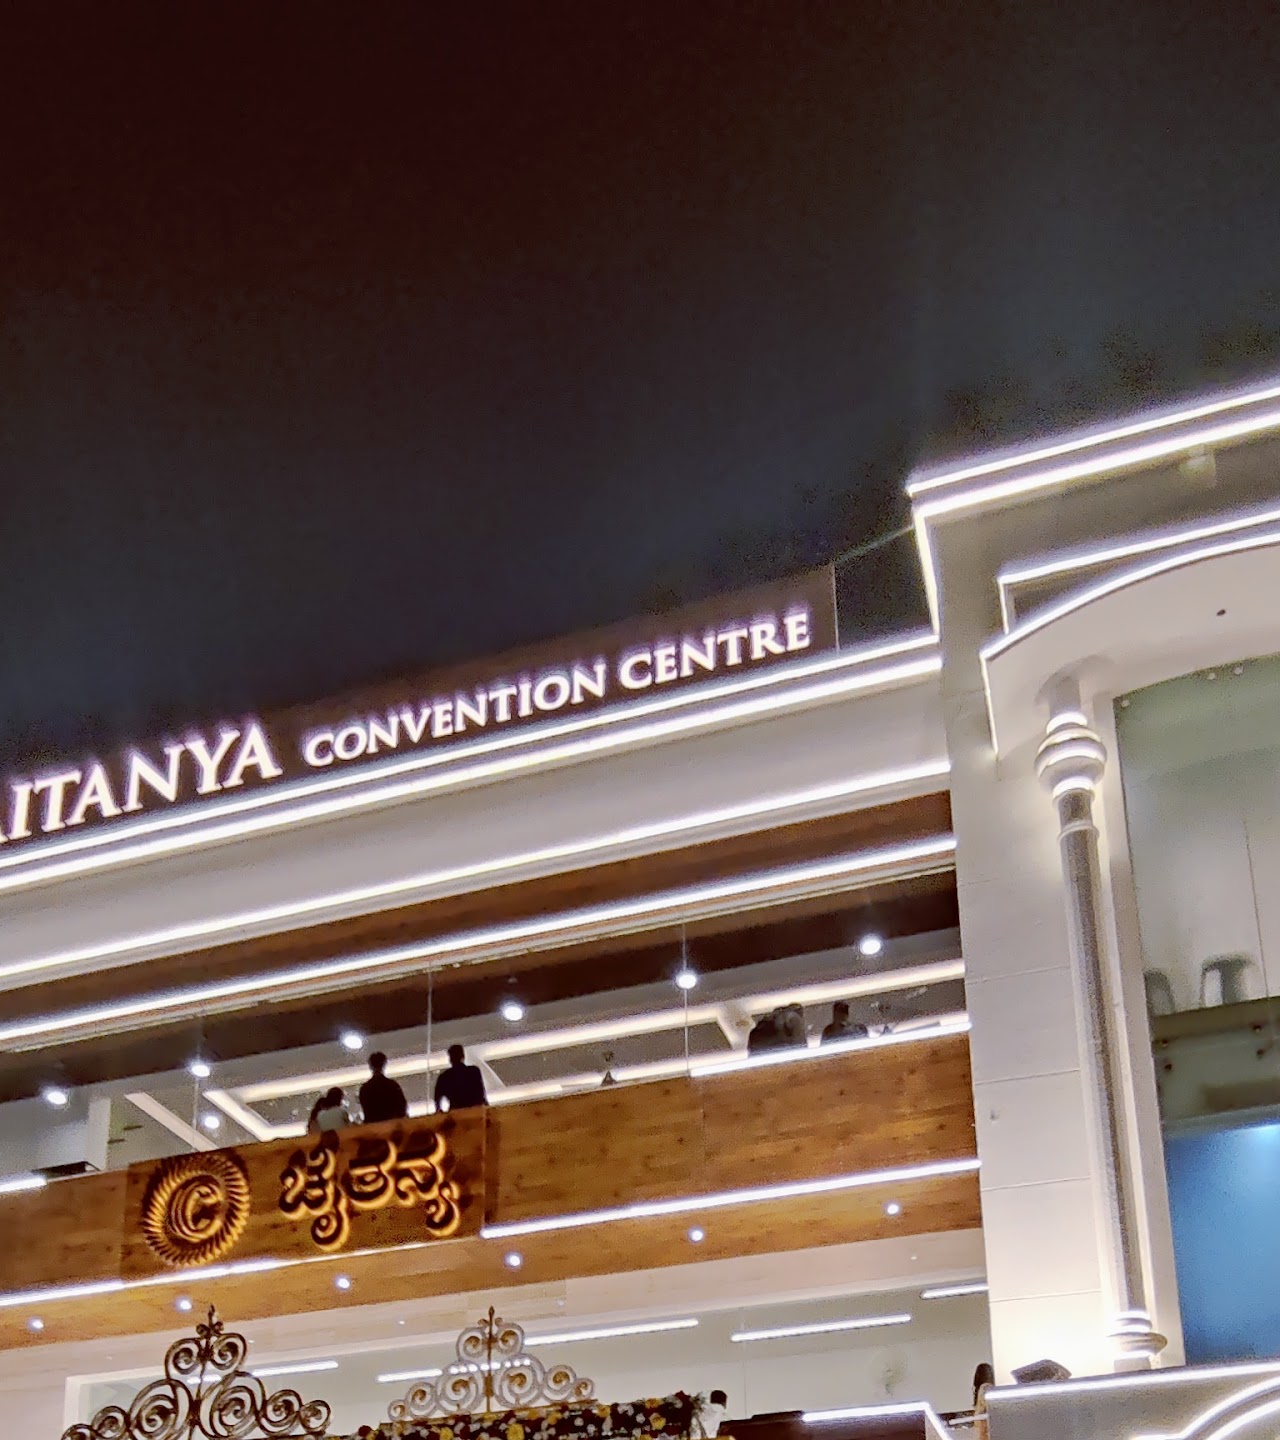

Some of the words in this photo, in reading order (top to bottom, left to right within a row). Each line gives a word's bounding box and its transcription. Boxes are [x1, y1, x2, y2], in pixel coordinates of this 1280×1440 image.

[303, 662, 608, 767] CONVENTION
[620, 612, 811, 690] CENTRE
[277, 1132, 461, 1252] ಚೈತನ್ಯ
